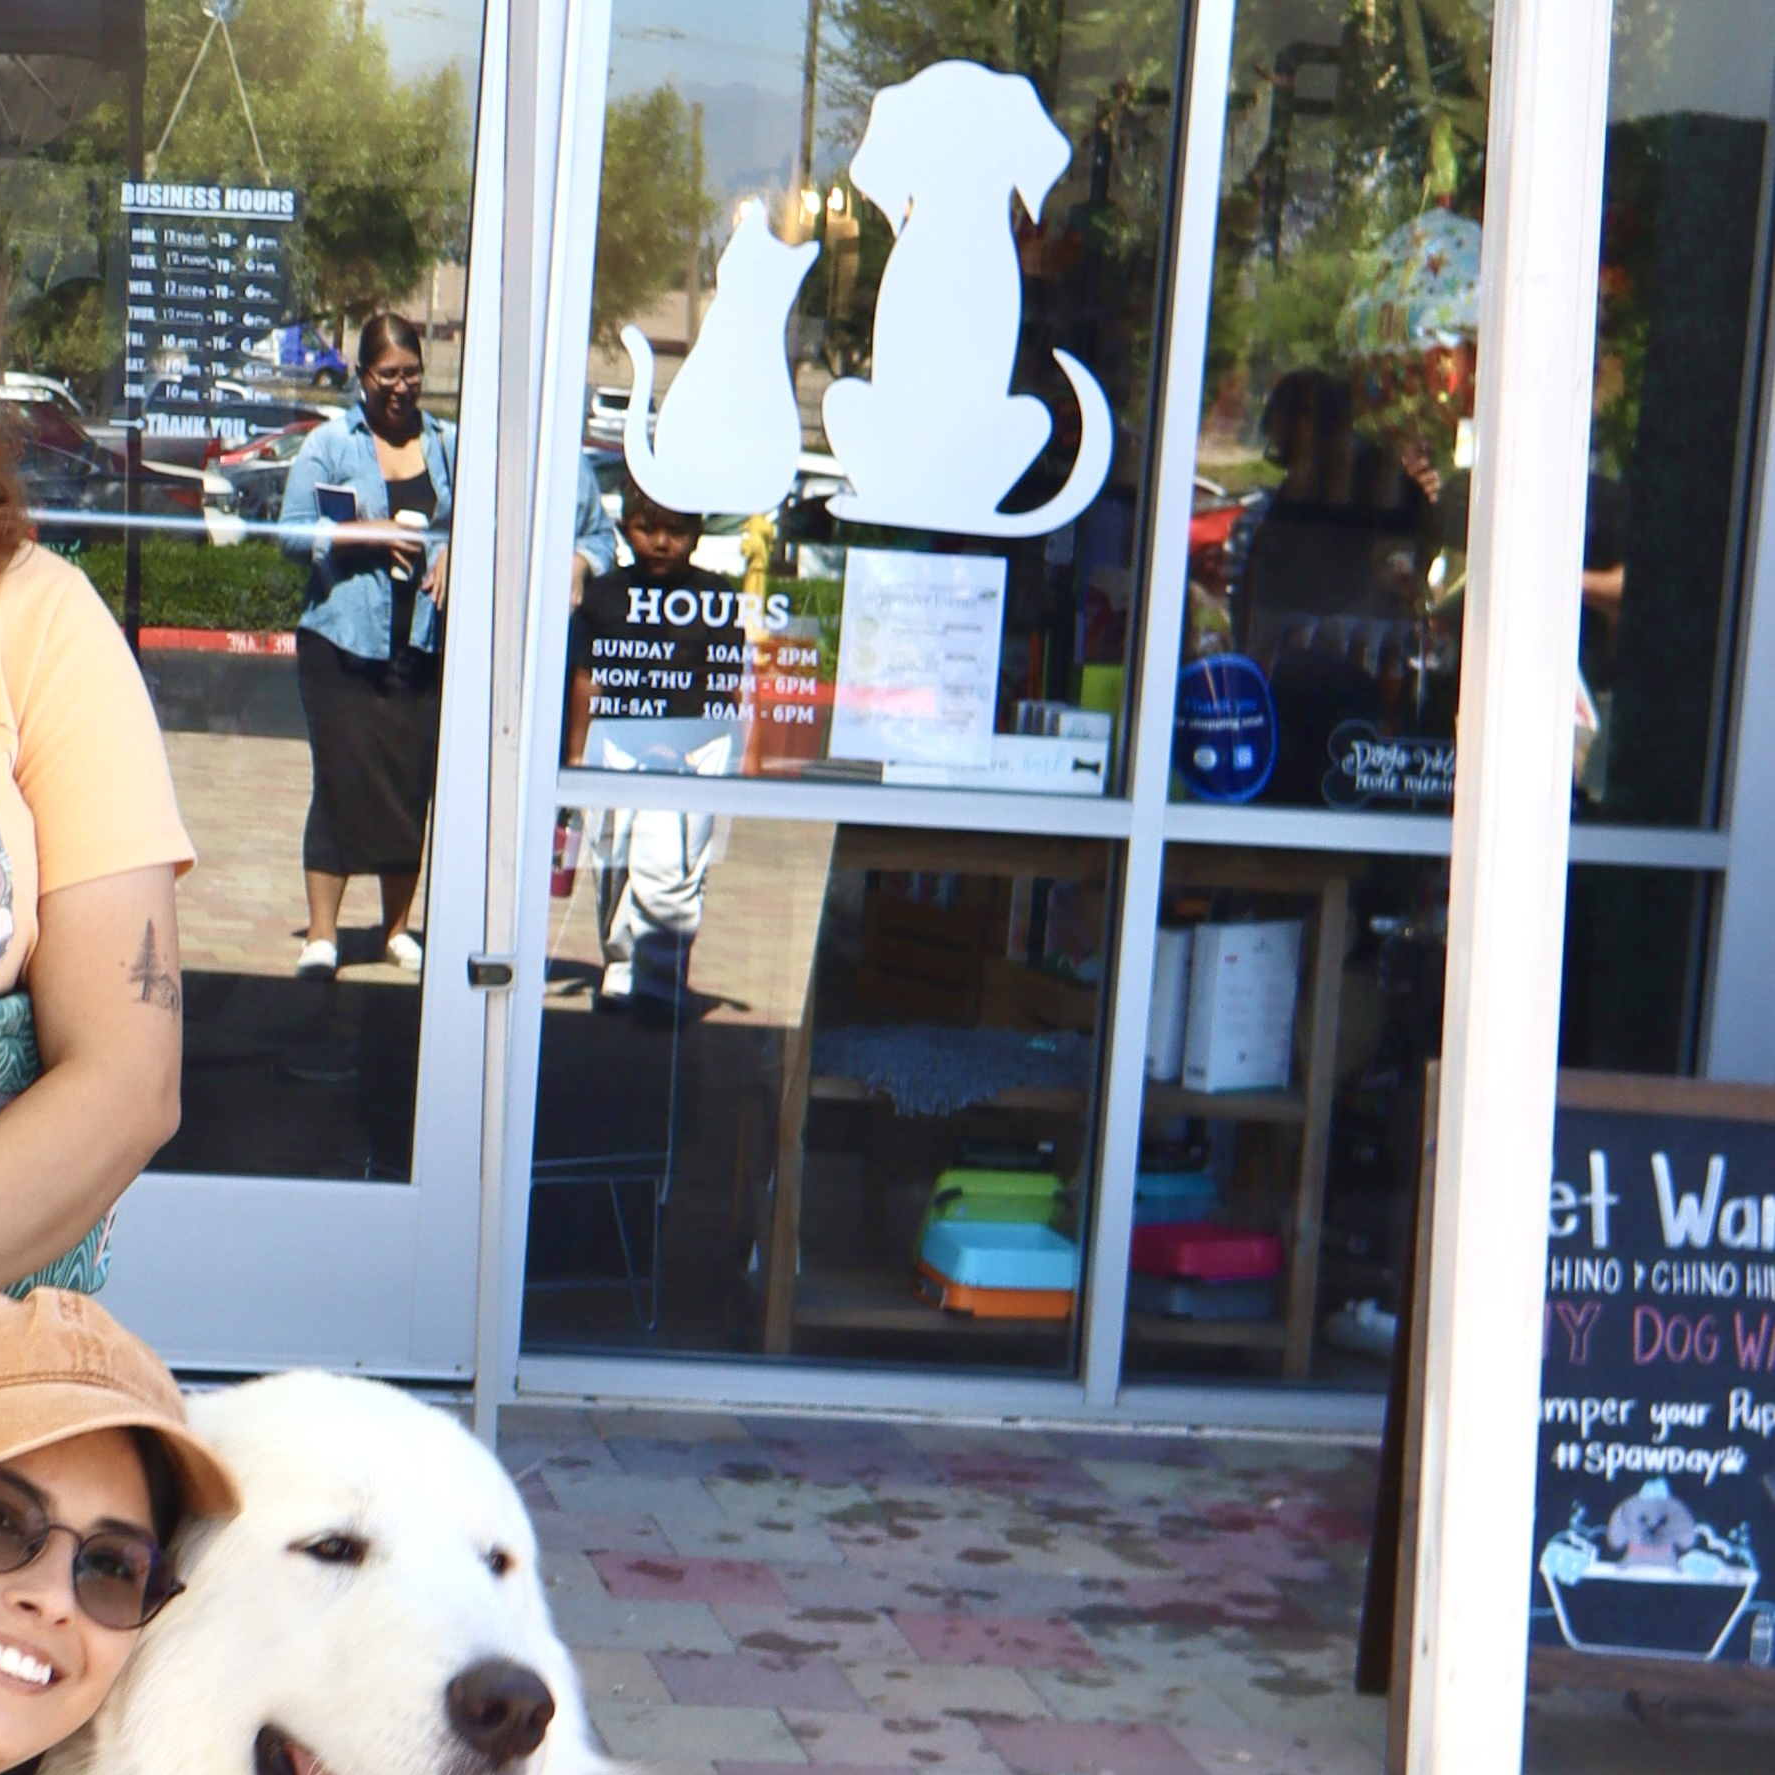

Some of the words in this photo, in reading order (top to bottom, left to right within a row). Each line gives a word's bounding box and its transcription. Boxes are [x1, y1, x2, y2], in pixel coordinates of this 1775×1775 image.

[121, 181, 221, 210] BUSINESS
[224, 188, 295, 214] HOURS
[146, 412, 206, 437] THANK
[210, 415, 246, 439] YOU
[625, 587, 790, 631] HOURS
[591, 638, 675, 661] SUNDAY
[705, 644, 760, 665] 10AM
[590, 667, 693, 690] MON-THU
[705, 672, 757, 693] 12PM
[775, 675, 817, 696] 6PM
[588, 696, 668, 717] FRI-SAT
[702, 701, 755, 722] 10AM
[772, 704, 815, 725] 6PM
[1548, 1149, 1621, 1250] et
[1550, 1255, 1624, 1295] HINO
[1651, 1260, 1740, 1296] CHINO
[1632, 1305, 1720, 1367] DOG
[1539, 1396, 1638, 1442] mper
[1649, 1400, 1714, 1445] your
